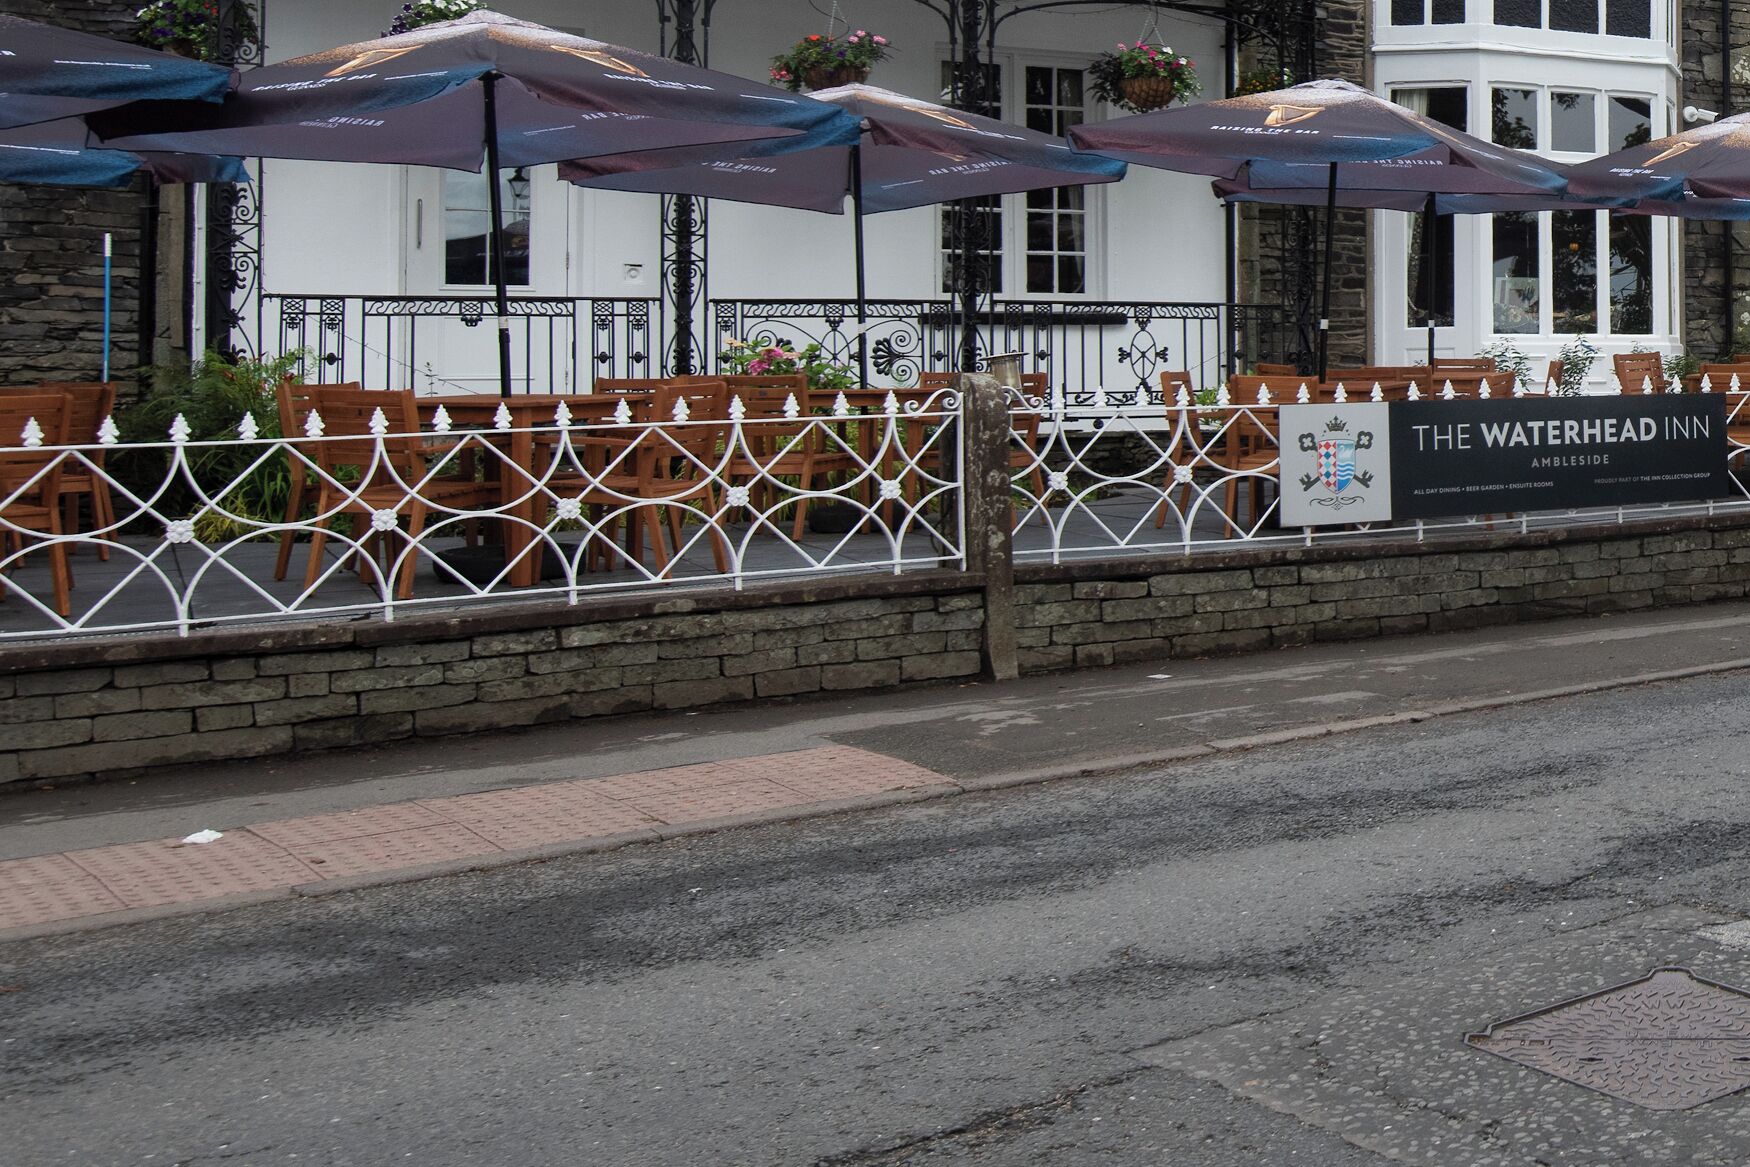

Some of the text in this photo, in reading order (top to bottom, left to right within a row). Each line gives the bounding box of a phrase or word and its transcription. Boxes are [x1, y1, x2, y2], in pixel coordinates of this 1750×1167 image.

[1412, 415, 1710, 451] THE WATERHEAD INN
[1531, 454, 1610, 468] AMBLESIDE
